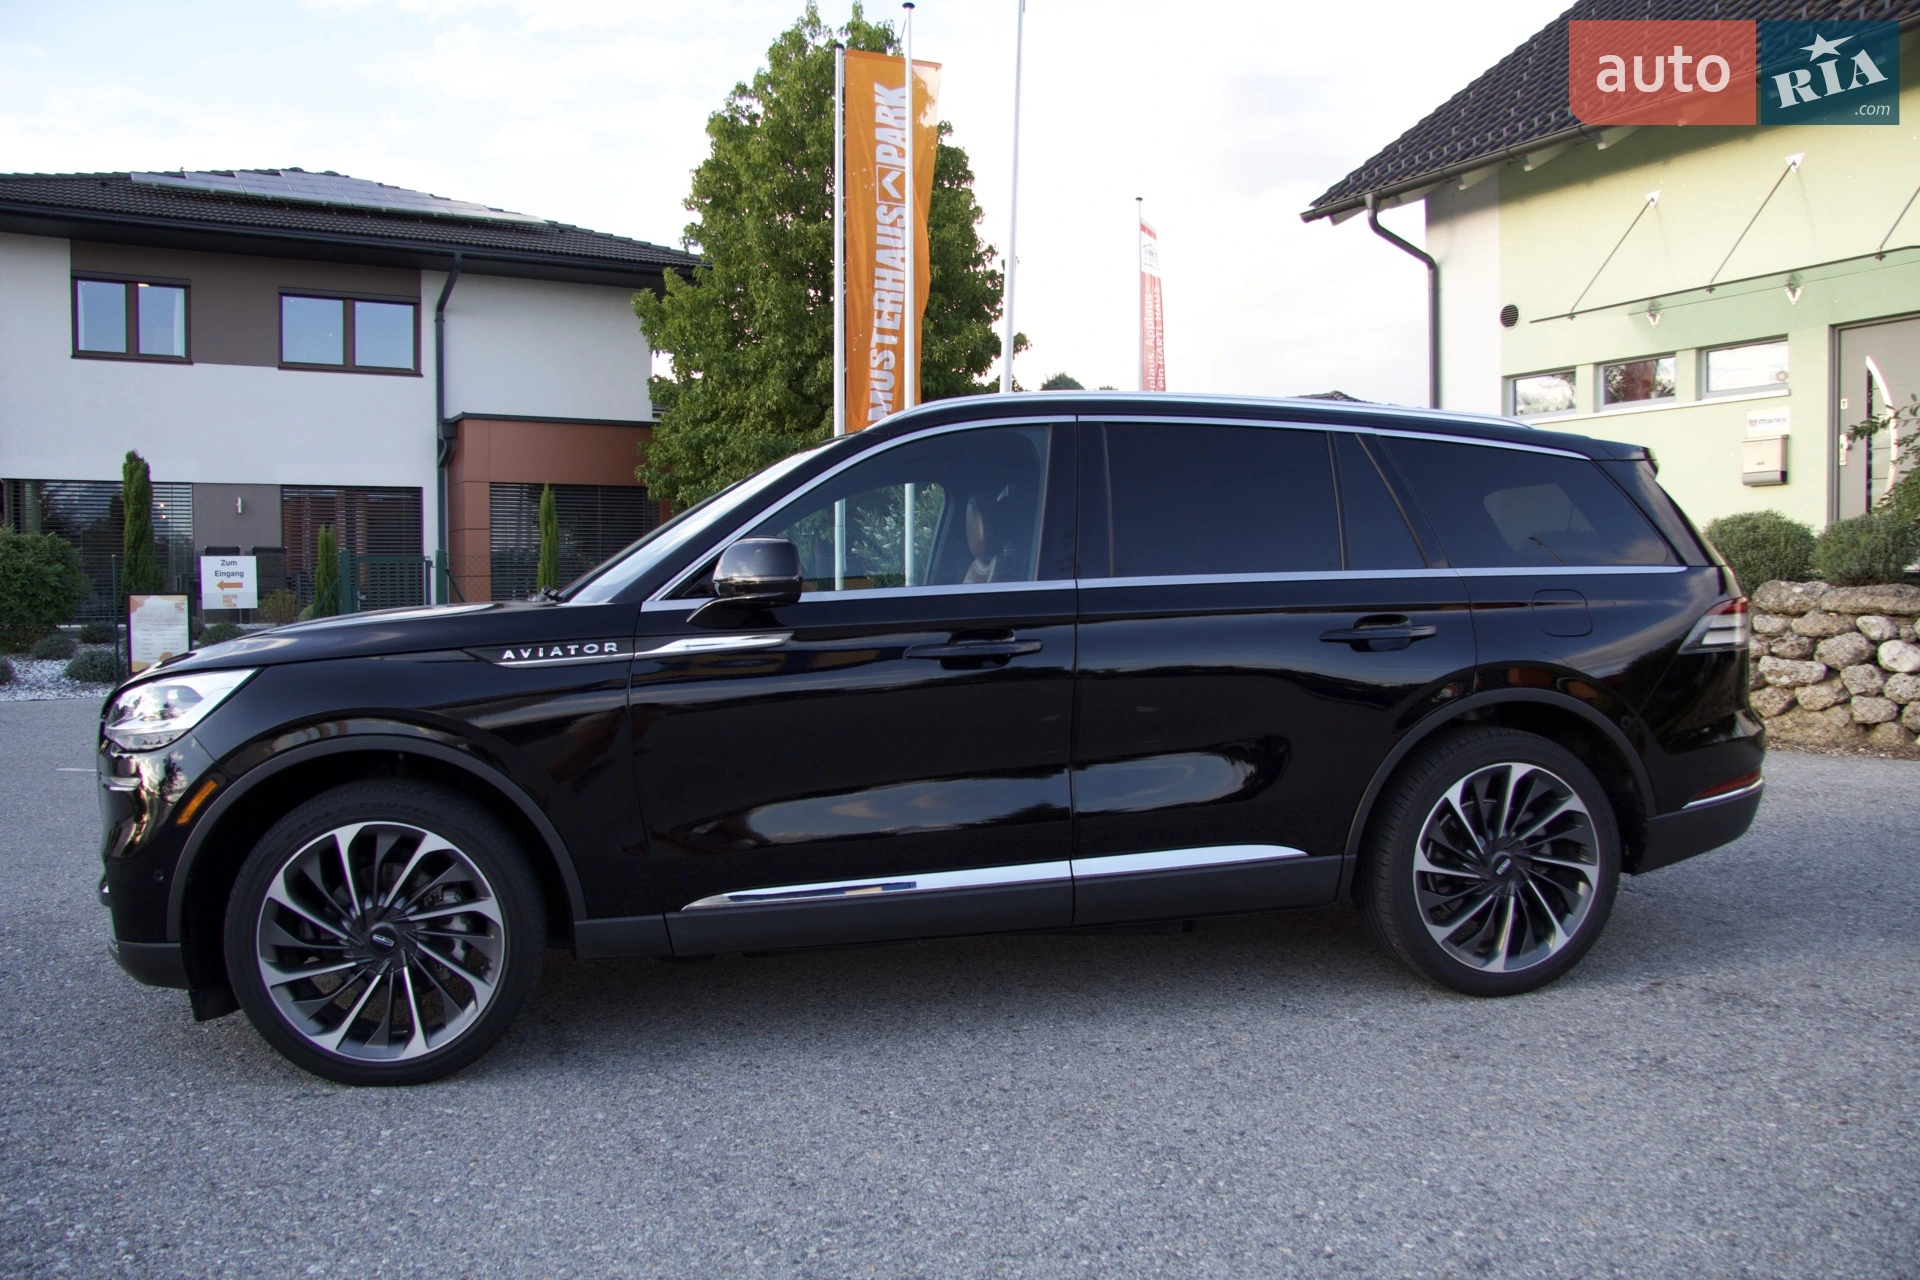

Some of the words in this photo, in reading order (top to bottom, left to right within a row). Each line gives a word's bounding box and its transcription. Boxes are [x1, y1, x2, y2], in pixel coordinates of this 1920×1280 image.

[874, 82, 906, 168] PARK
[867, 204, 906, 420] MUSTERHAUS
[1145, 294, 1155, 346] Applaus
[1147, 349, 1156, 391] plaus,
[502, 642, 618, 660] AVIATOR
